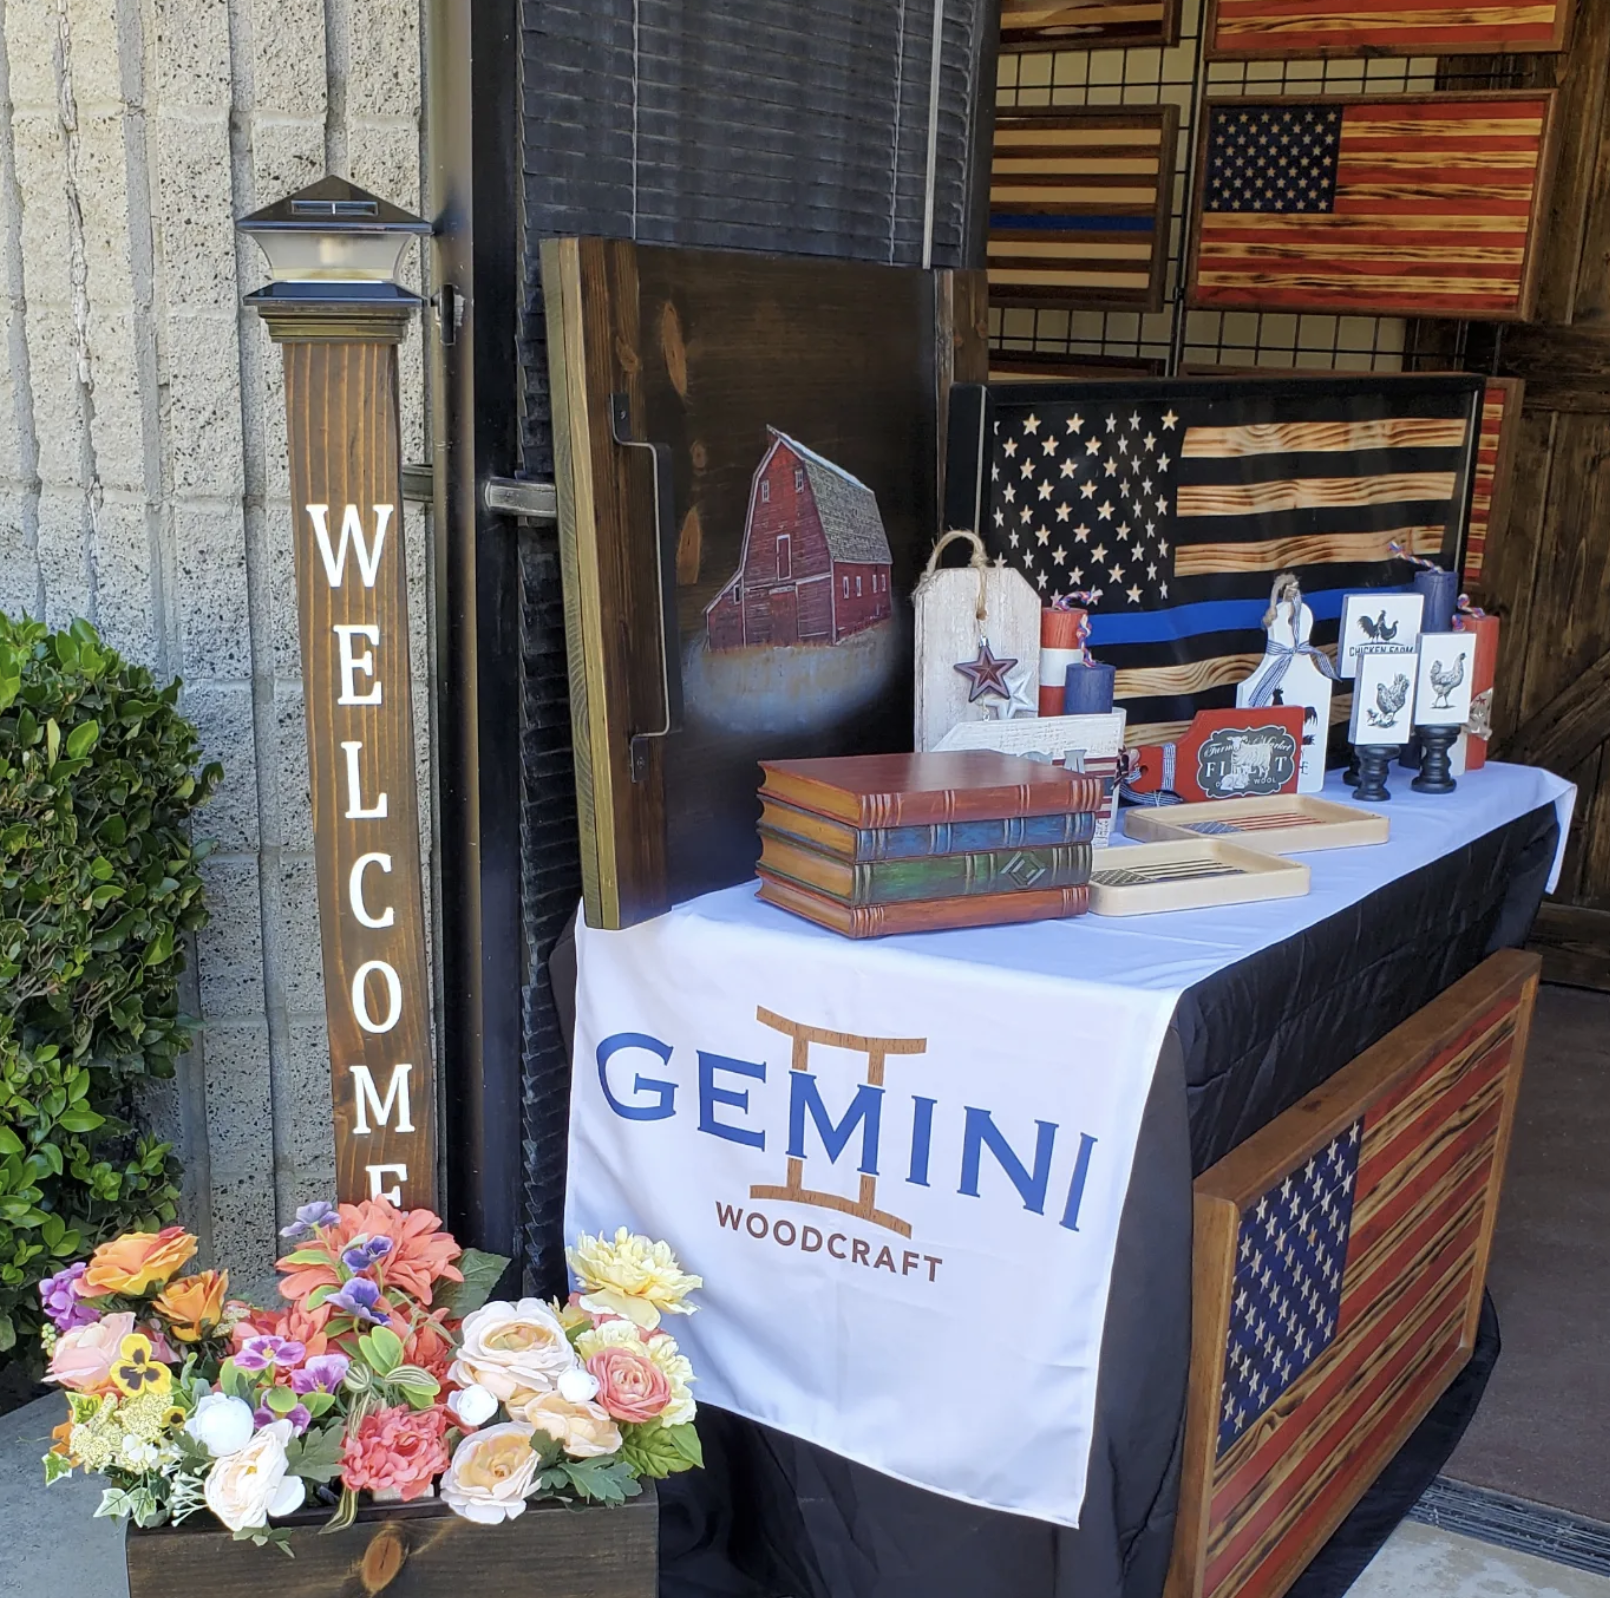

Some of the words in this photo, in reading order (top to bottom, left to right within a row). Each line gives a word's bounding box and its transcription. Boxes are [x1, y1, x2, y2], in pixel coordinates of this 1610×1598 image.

[1349, 646, 1387, 657] CHICKEN
[305, 503, 413, 1208] WELCOME
[595, 1032, 1098, 1232] GEMINI
[715, 1201, 943, 1283] WOODCRAFT
